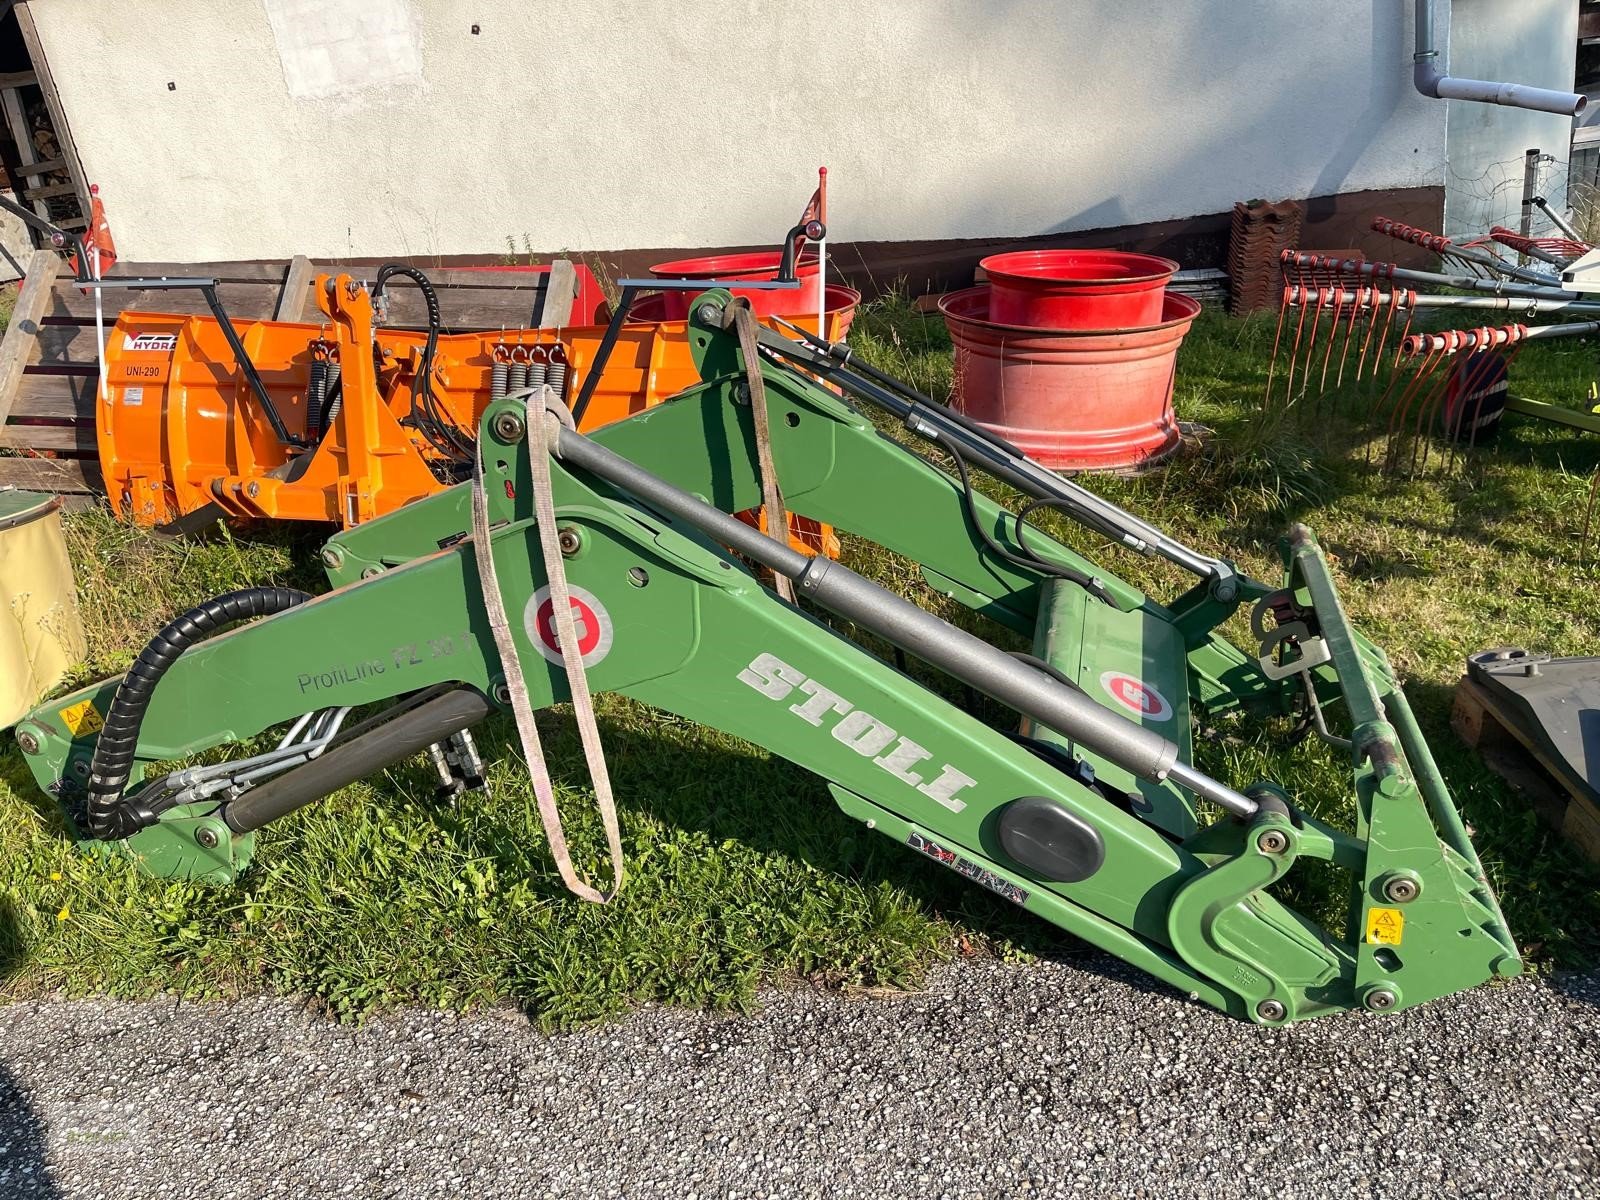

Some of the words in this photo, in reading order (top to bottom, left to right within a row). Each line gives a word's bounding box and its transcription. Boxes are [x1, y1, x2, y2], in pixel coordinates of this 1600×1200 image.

[126, 366, 159, 376] UNI-290
[297, 659, 386, 694] ProfiLine
[736, 652, 978, 814] STOLL
